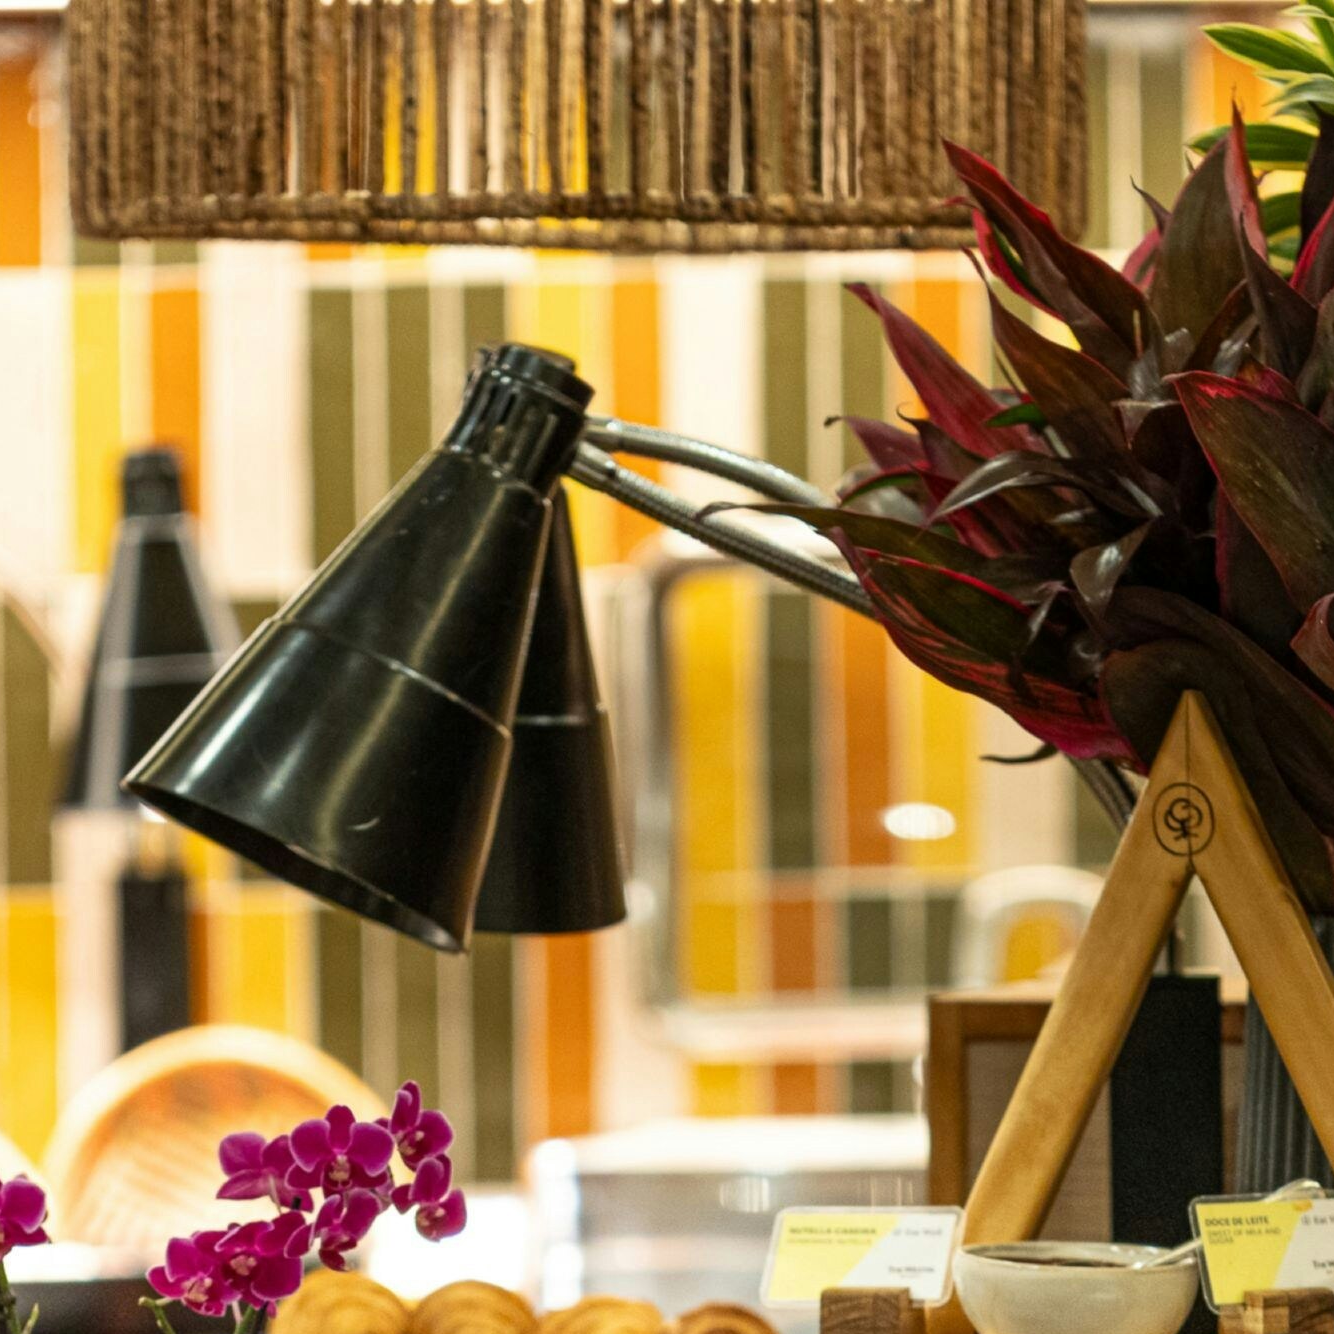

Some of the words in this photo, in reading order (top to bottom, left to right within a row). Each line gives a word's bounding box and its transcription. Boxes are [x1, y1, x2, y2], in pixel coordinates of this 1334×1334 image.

[1205, 1217, 1230, 1226] DOCE
[1232, 1217, 1243, 1225] DE
[1245, 1215, 1269, 1225] LEITE
